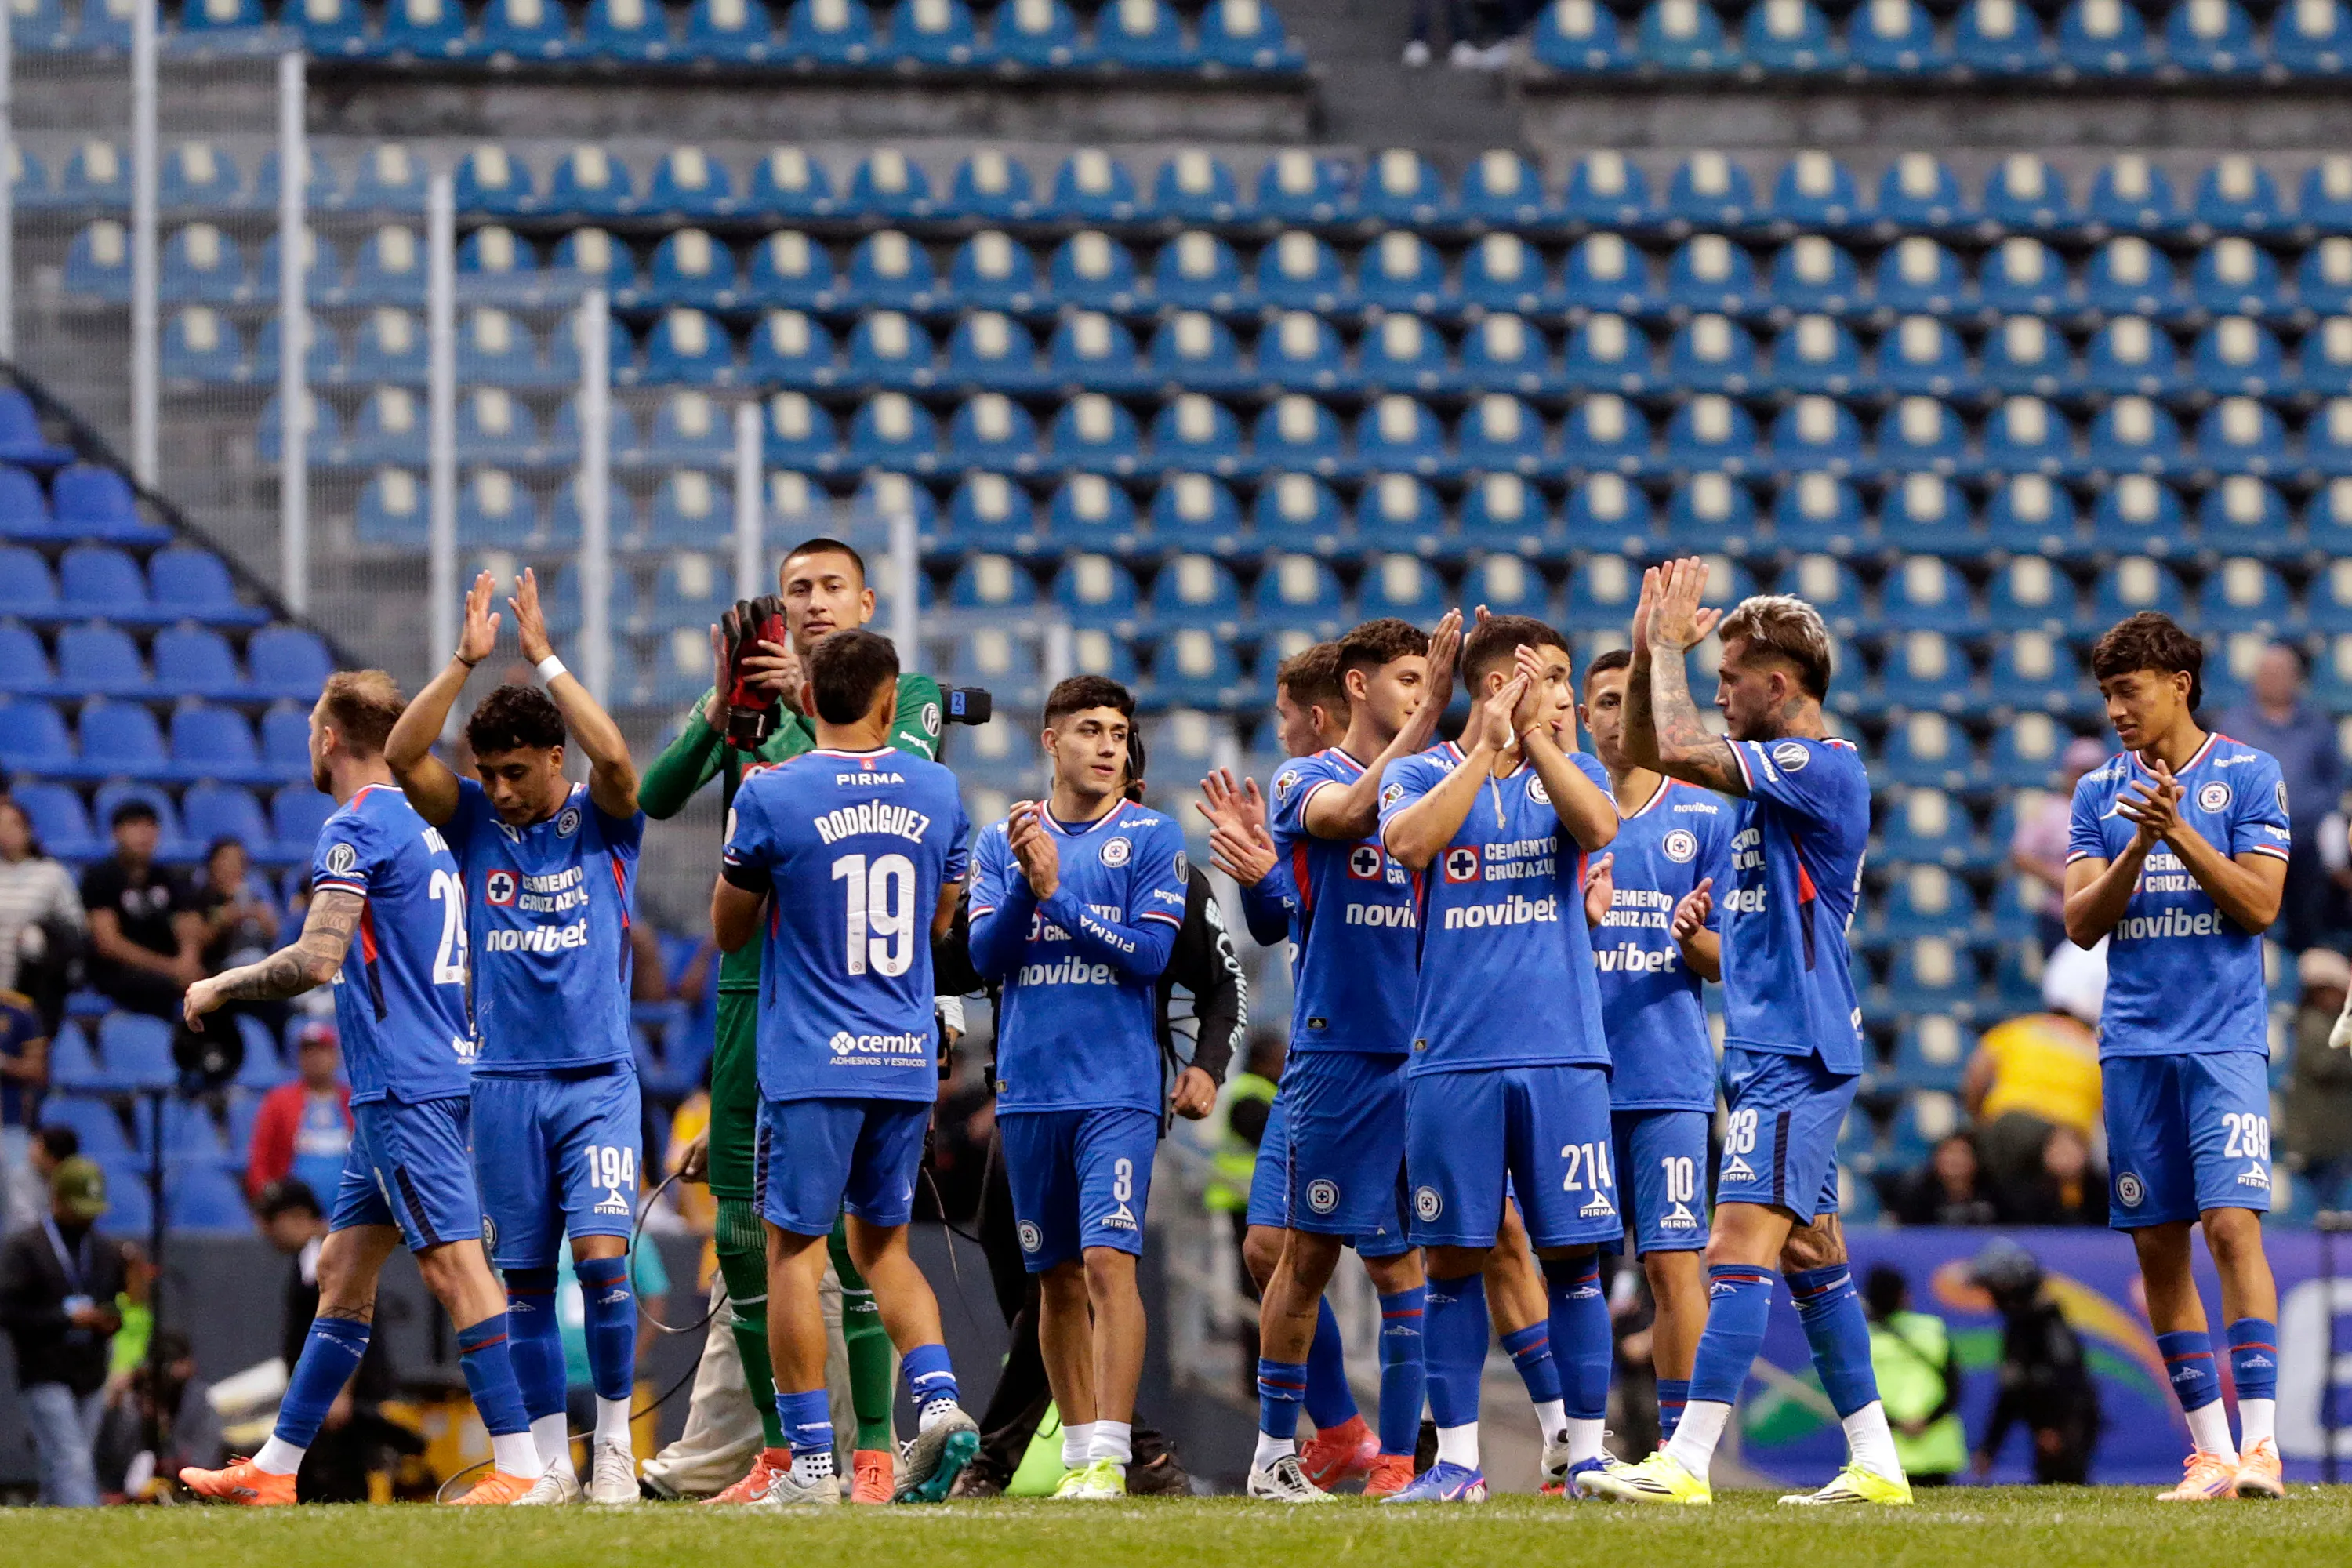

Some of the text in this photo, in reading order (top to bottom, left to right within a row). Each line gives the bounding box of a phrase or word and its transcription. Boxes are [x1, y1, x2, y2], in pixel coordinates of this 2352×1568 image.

[836, 772, 905, 785] PIRMA
[813, 799, 930, 844] RODRÍGUEZ
[1673, 802, 1719, 815] novibet
[1484, 836, 1557, 860] CEMENTO
[522, 866, 583, 893] CEMENTO
[1386, 868, 1406, 884] CR
[1484, 862, 1524, 881] CRUZ
[2145, 874, 2187, 892] CRUZ
[518, 885, 588, 913] CRUZ AZUL
[1444, 895, 1558, 929] novibet
[1611, 889, 1673, 912] EMENO
[831, 853, 916, 977] 19
[1345, 899, 1416, 928] novi
[1601, 909, 1668, 929] CRUZ AZU
[2118, 907, 2223, 941] novibet
[486, 917, 587, 952] novibet
[1080, 913, 1136, 953] PIRMA
[1018, 955, 1120, 988] novibet
[1592, 942, 1677, 974] vibet
[857, 1032, 923, 1054] cemix
[829, 1056, 927, 1067] ADHESIVOS Y ESTUCOS
[1725, 1108, 1759, 1155] 33
[2222, 1112, 2269, 1161] 239
[584, 1145, 634, 1191] 194
[1561, 1141, 1612, 1191] 214
[1661, 1156, 1693, 1203] 10
[1721, 1173, 1757, 1183] PIRMA
[1113, 1157, 1133, 1203] 3
[2237, 1176, 2271, 1190] PIRMA
[594, 1206, 630, 1216] PIRMA
[1102, 1218, 1138, 1231] PIRMA
[1580, 1207, 1616, 1218] PIRMA
[1660, 1219, 1698, 1229] PIRMA
